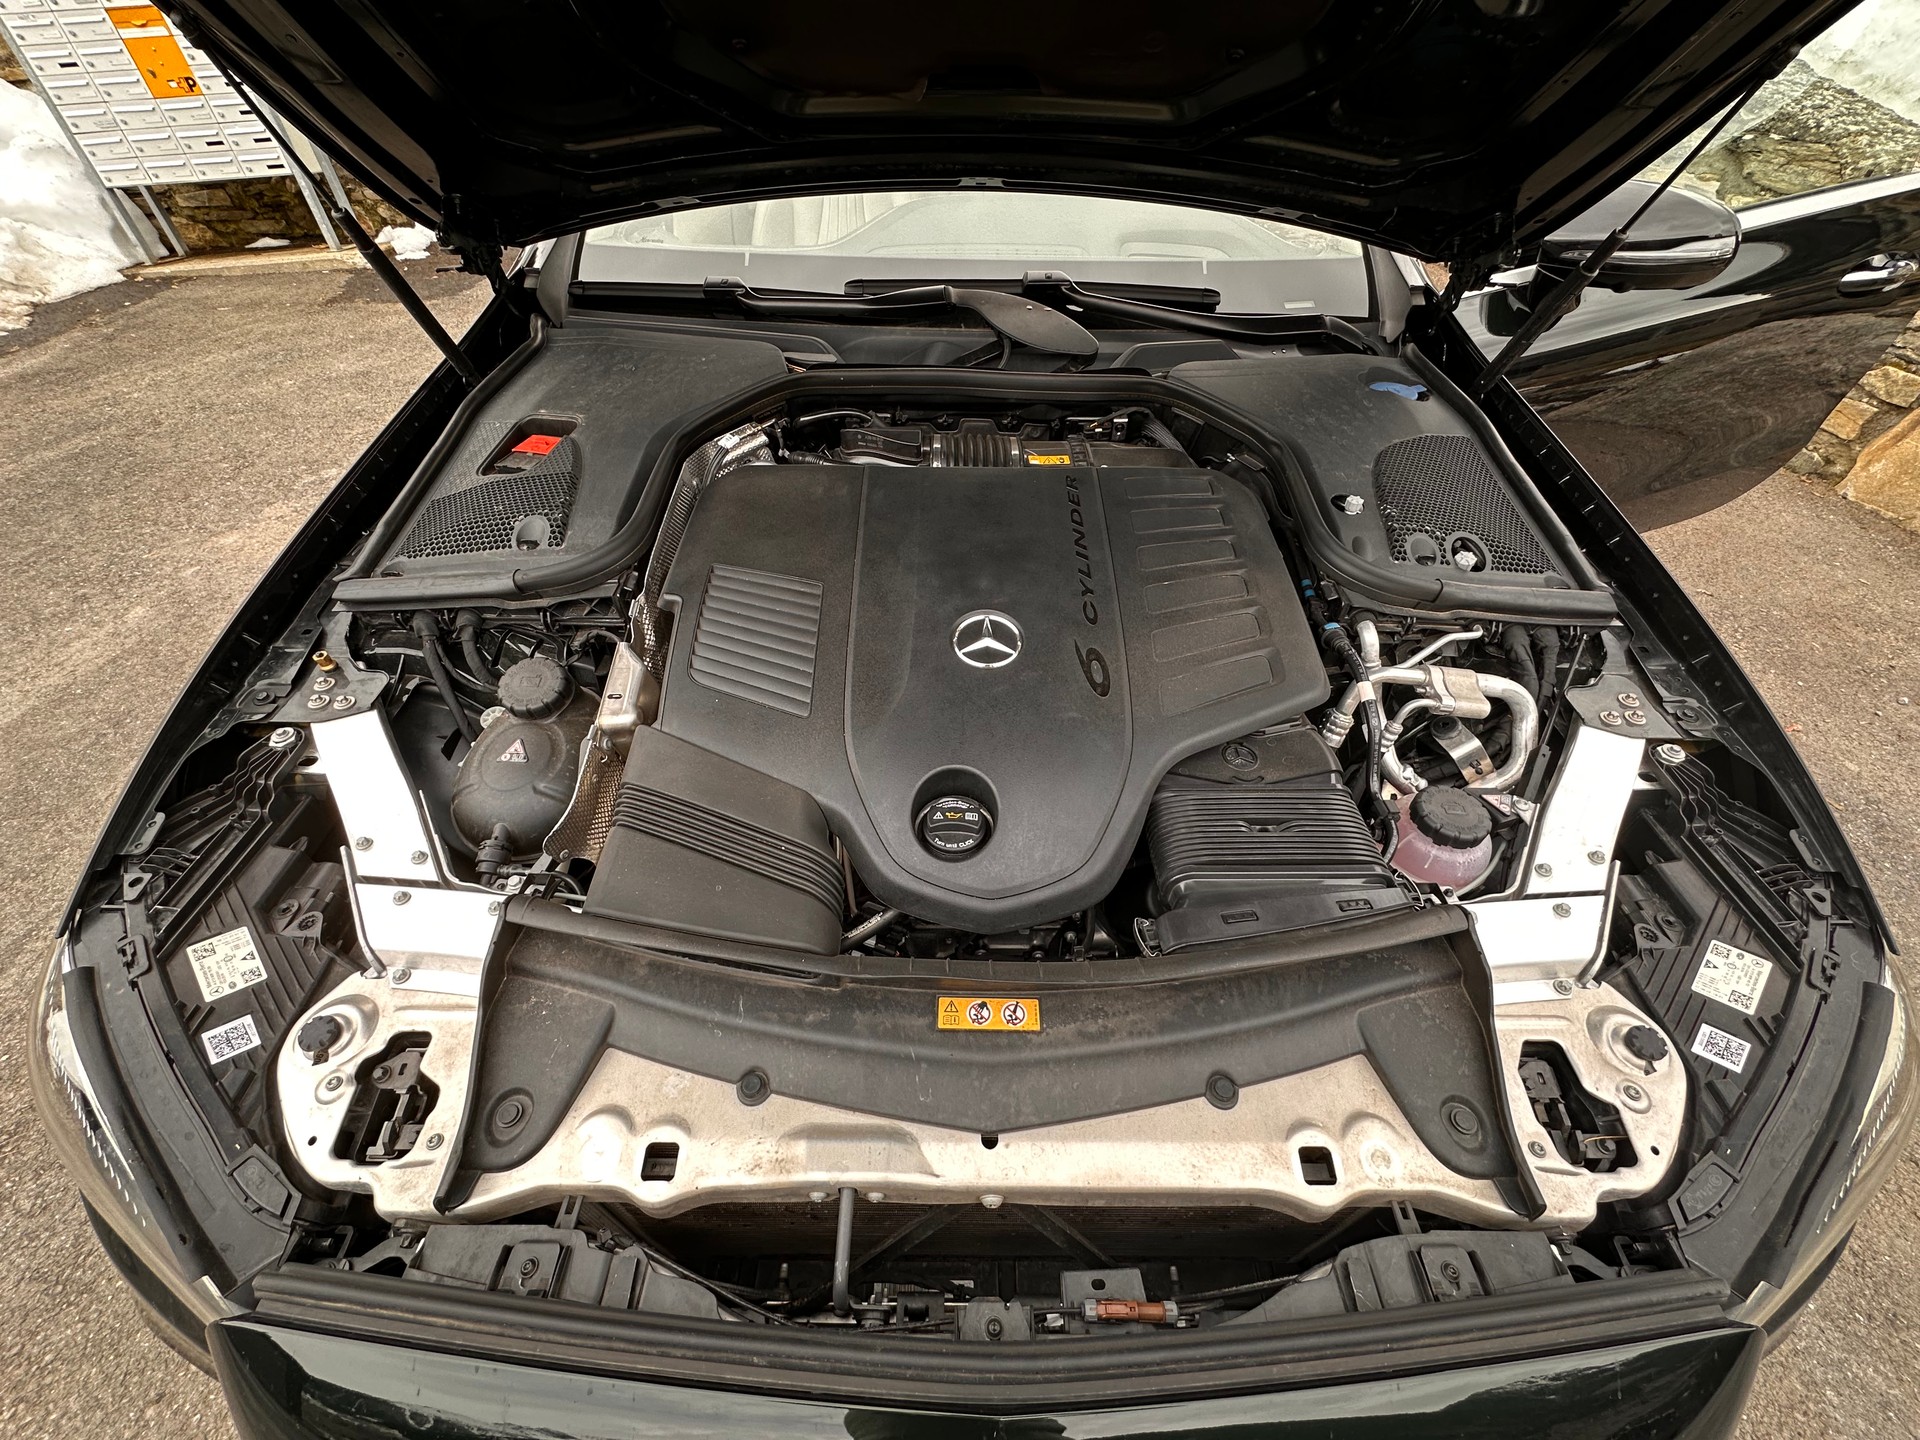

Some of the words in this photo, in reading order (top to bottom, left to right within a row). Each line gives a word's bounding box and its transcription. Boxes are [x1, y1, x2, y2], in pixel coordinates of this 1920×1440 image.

[1066, 474, 1099, 626] CYLINDER
[1074, 638, 1111, 698] 6
[934, 838, 944, 846] Turn
[958, 838, 974, 848] CLICK
